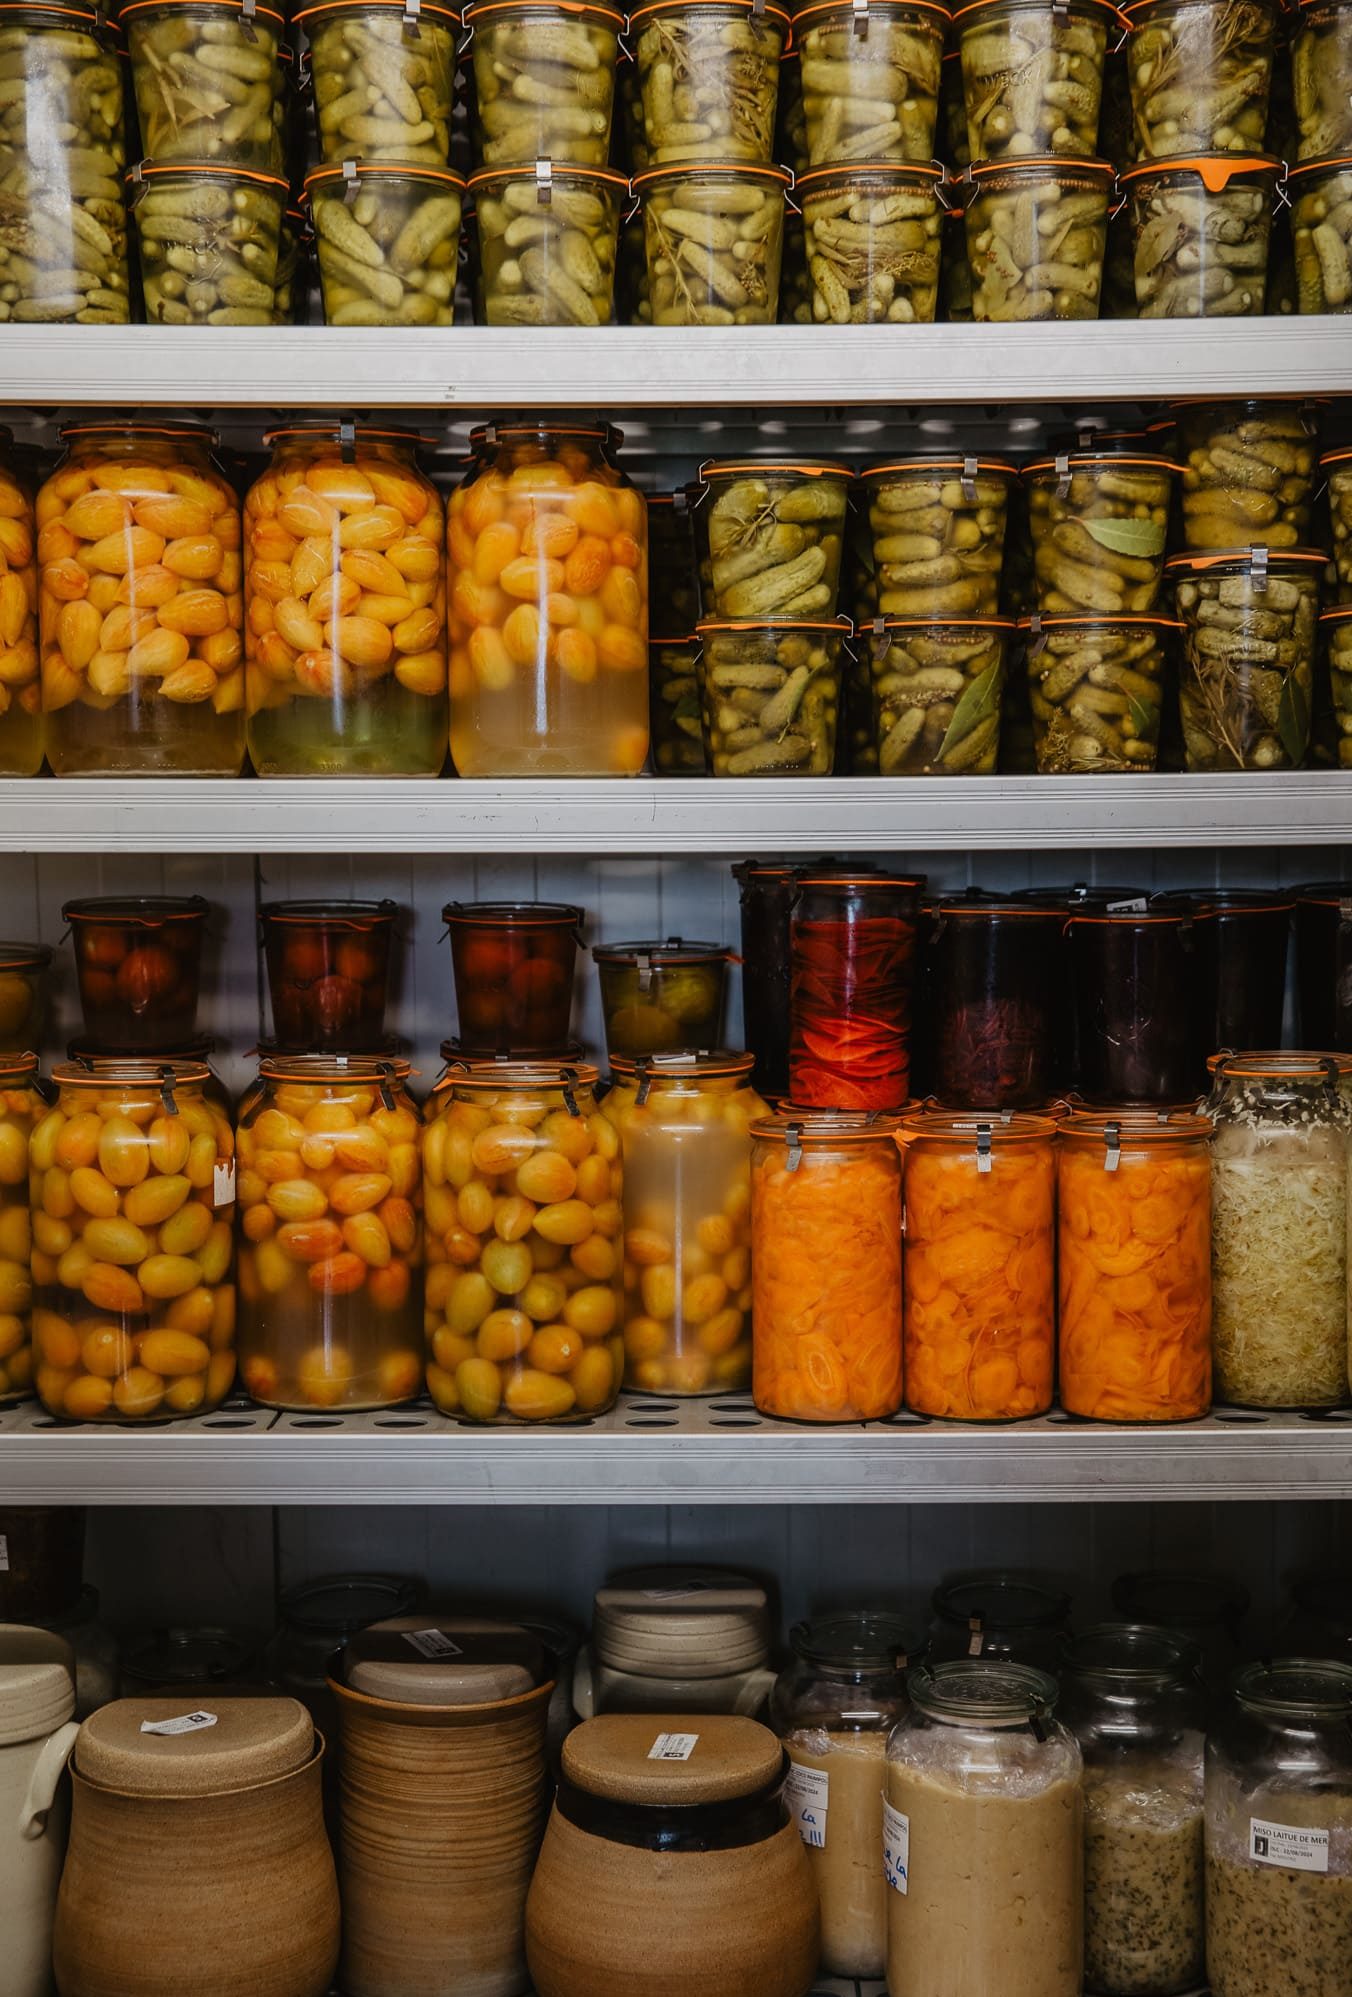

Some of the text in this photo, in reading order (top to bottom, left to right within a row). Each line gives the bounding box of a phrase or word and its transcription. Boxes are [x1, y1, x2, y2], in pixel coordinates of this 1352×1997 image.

[983, 70, 1032, 86] WECK
[1253, 1826, 1328, 1845] MISO LAITUE DE MER
